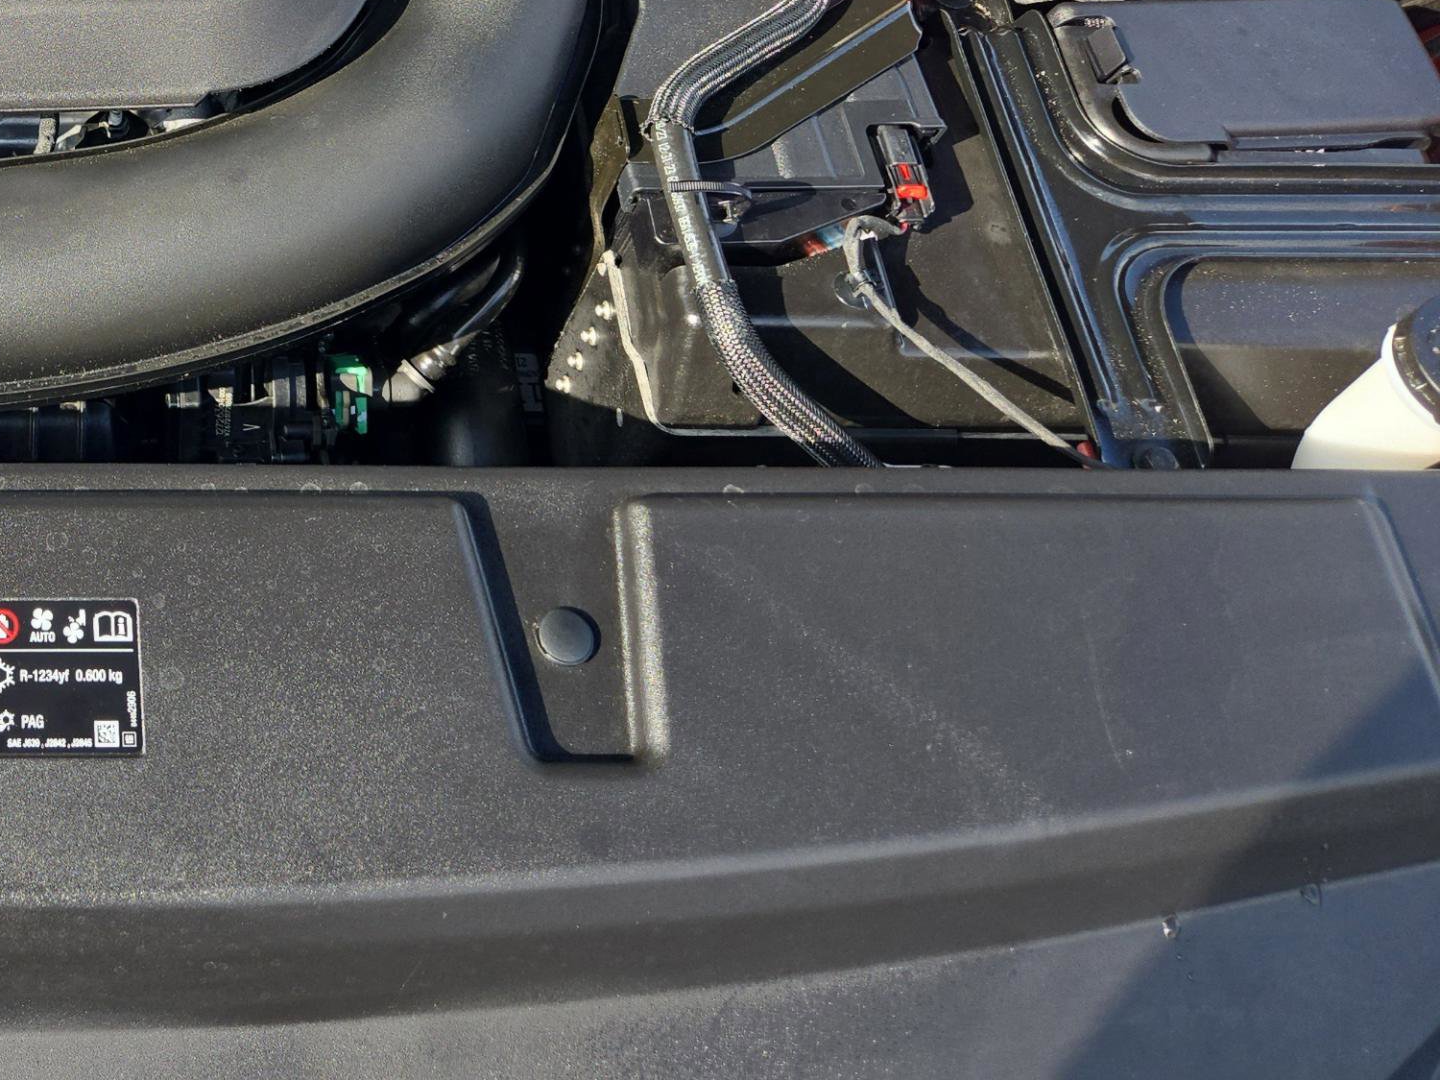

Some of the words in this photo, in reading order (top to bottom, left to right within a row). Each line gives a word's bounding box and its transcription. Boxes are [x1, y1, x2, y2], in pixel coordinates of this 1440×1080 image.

[29, 631, 56, 643] AUTO
[19, 669, 70, 684] R-1234yf
[75, 670, 107, 682] 0.600
[108, 669, 123, 684] kg
[21, 714, 45, 729] PAG
